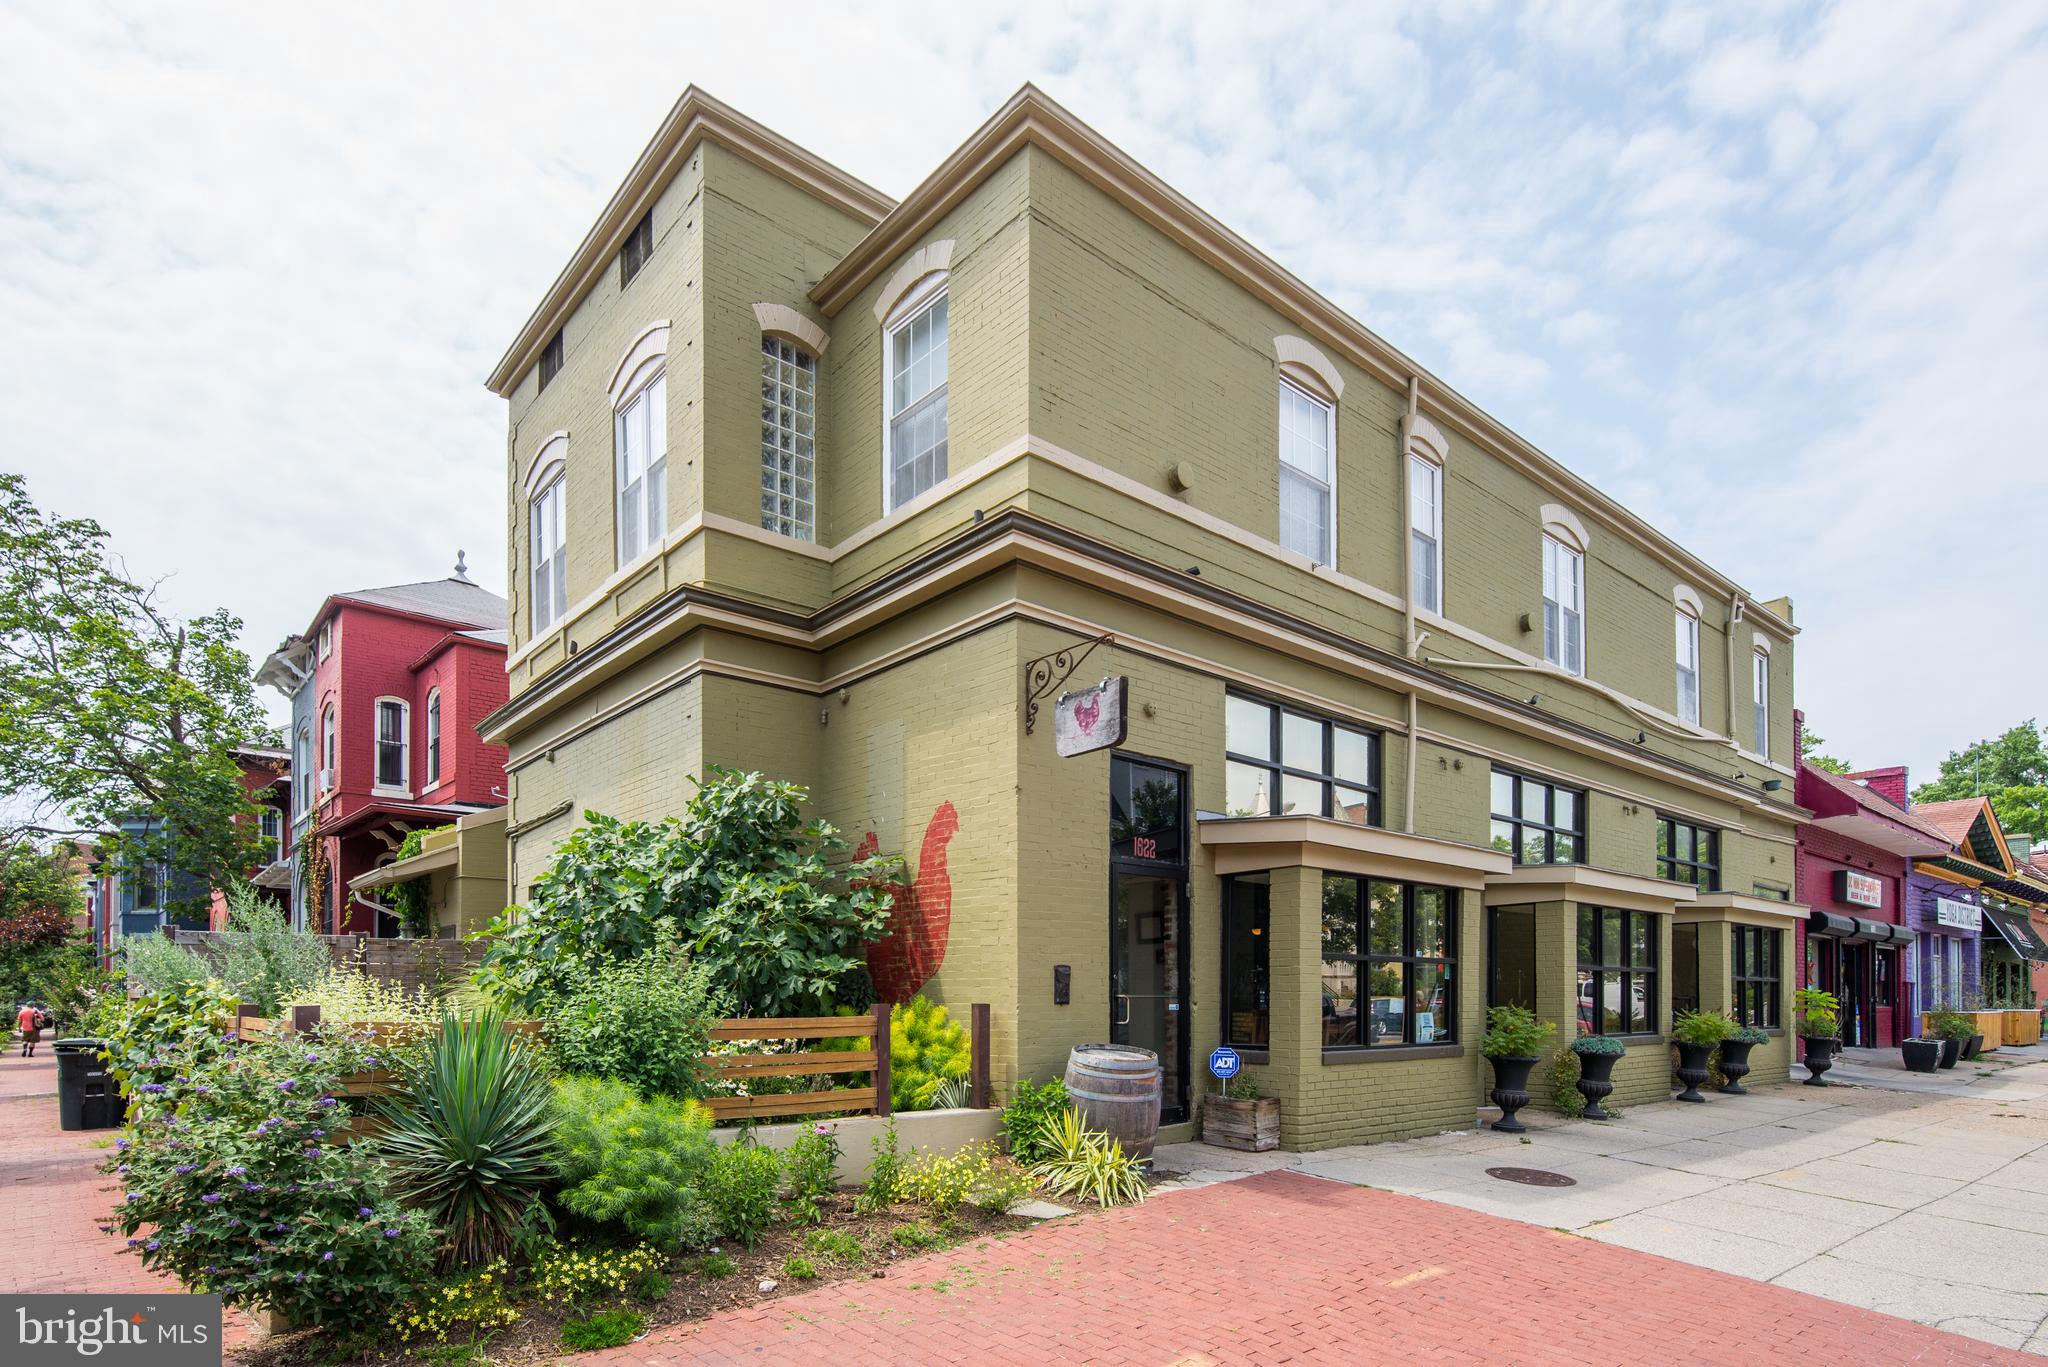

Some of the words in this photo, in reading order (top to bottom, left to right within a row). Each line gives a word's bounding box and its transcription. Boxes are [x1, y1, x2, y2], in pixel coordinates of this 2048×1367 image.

[1946, 902, 1957, 924] YOGA
[1957, 904, 1976, 928] DISTRICT
[1215, 1057, 1235, 1069] ADT
